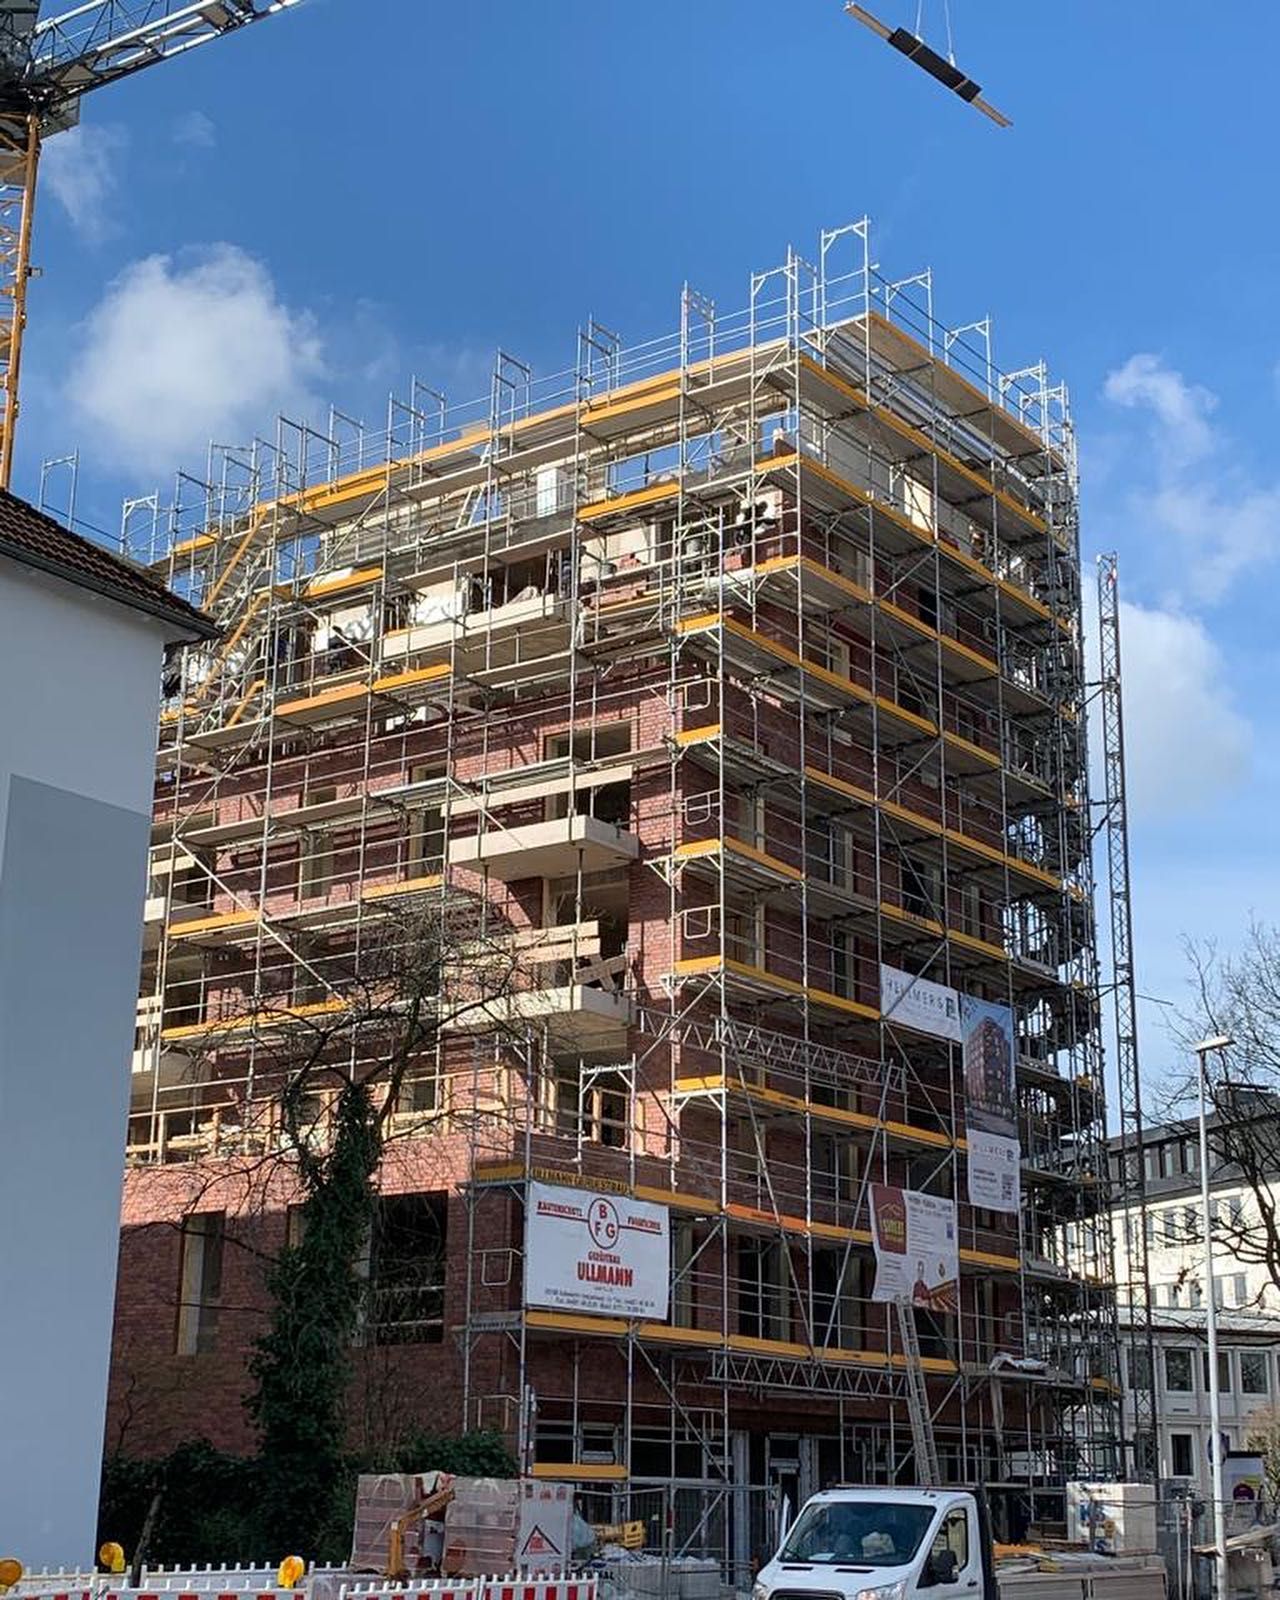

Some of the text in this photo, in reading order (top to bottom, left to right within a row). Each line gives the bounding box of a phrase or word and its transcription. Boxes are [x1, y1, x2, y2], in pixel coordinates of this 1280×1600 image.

[599, 1204, 607, 1219] B
[595, 1221, 615, 1239] F G
[577, 1262, 633, 1287] ULLMANN
